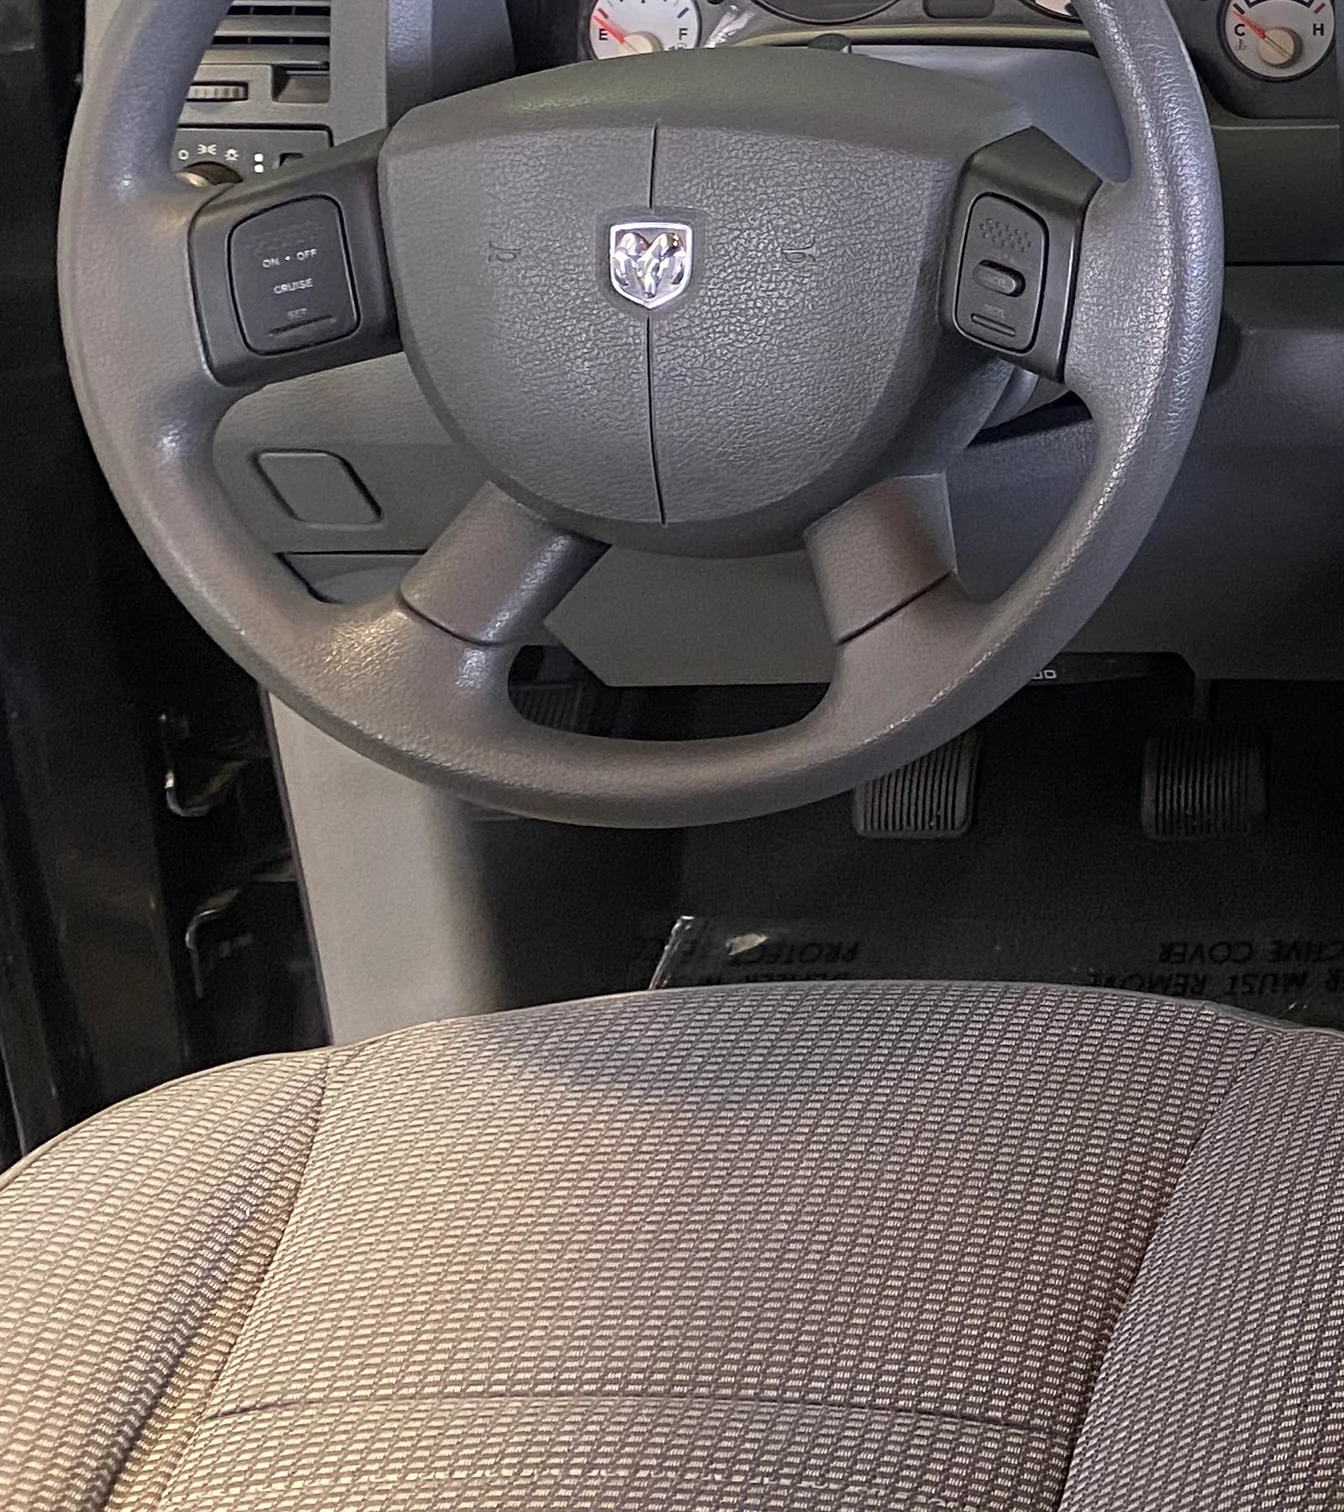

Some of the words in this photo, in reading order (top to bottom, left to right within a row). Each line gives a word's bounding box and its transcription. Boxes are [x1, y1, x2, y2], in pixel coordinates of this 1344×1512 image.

[598, 28, 609, 41] E
[679, 27, 688, 41] F
[1234, 23, 1246, 37] C
[1313, 23, 1325, 36] H
[262, 257, 280, 268] ON
[296, 248, 317, 261] OFF
[273, 277, 313, 295] CRUISE
[1158, 940, 1254, 965] COVER
[1227, 970, 1307, 996] MUST
